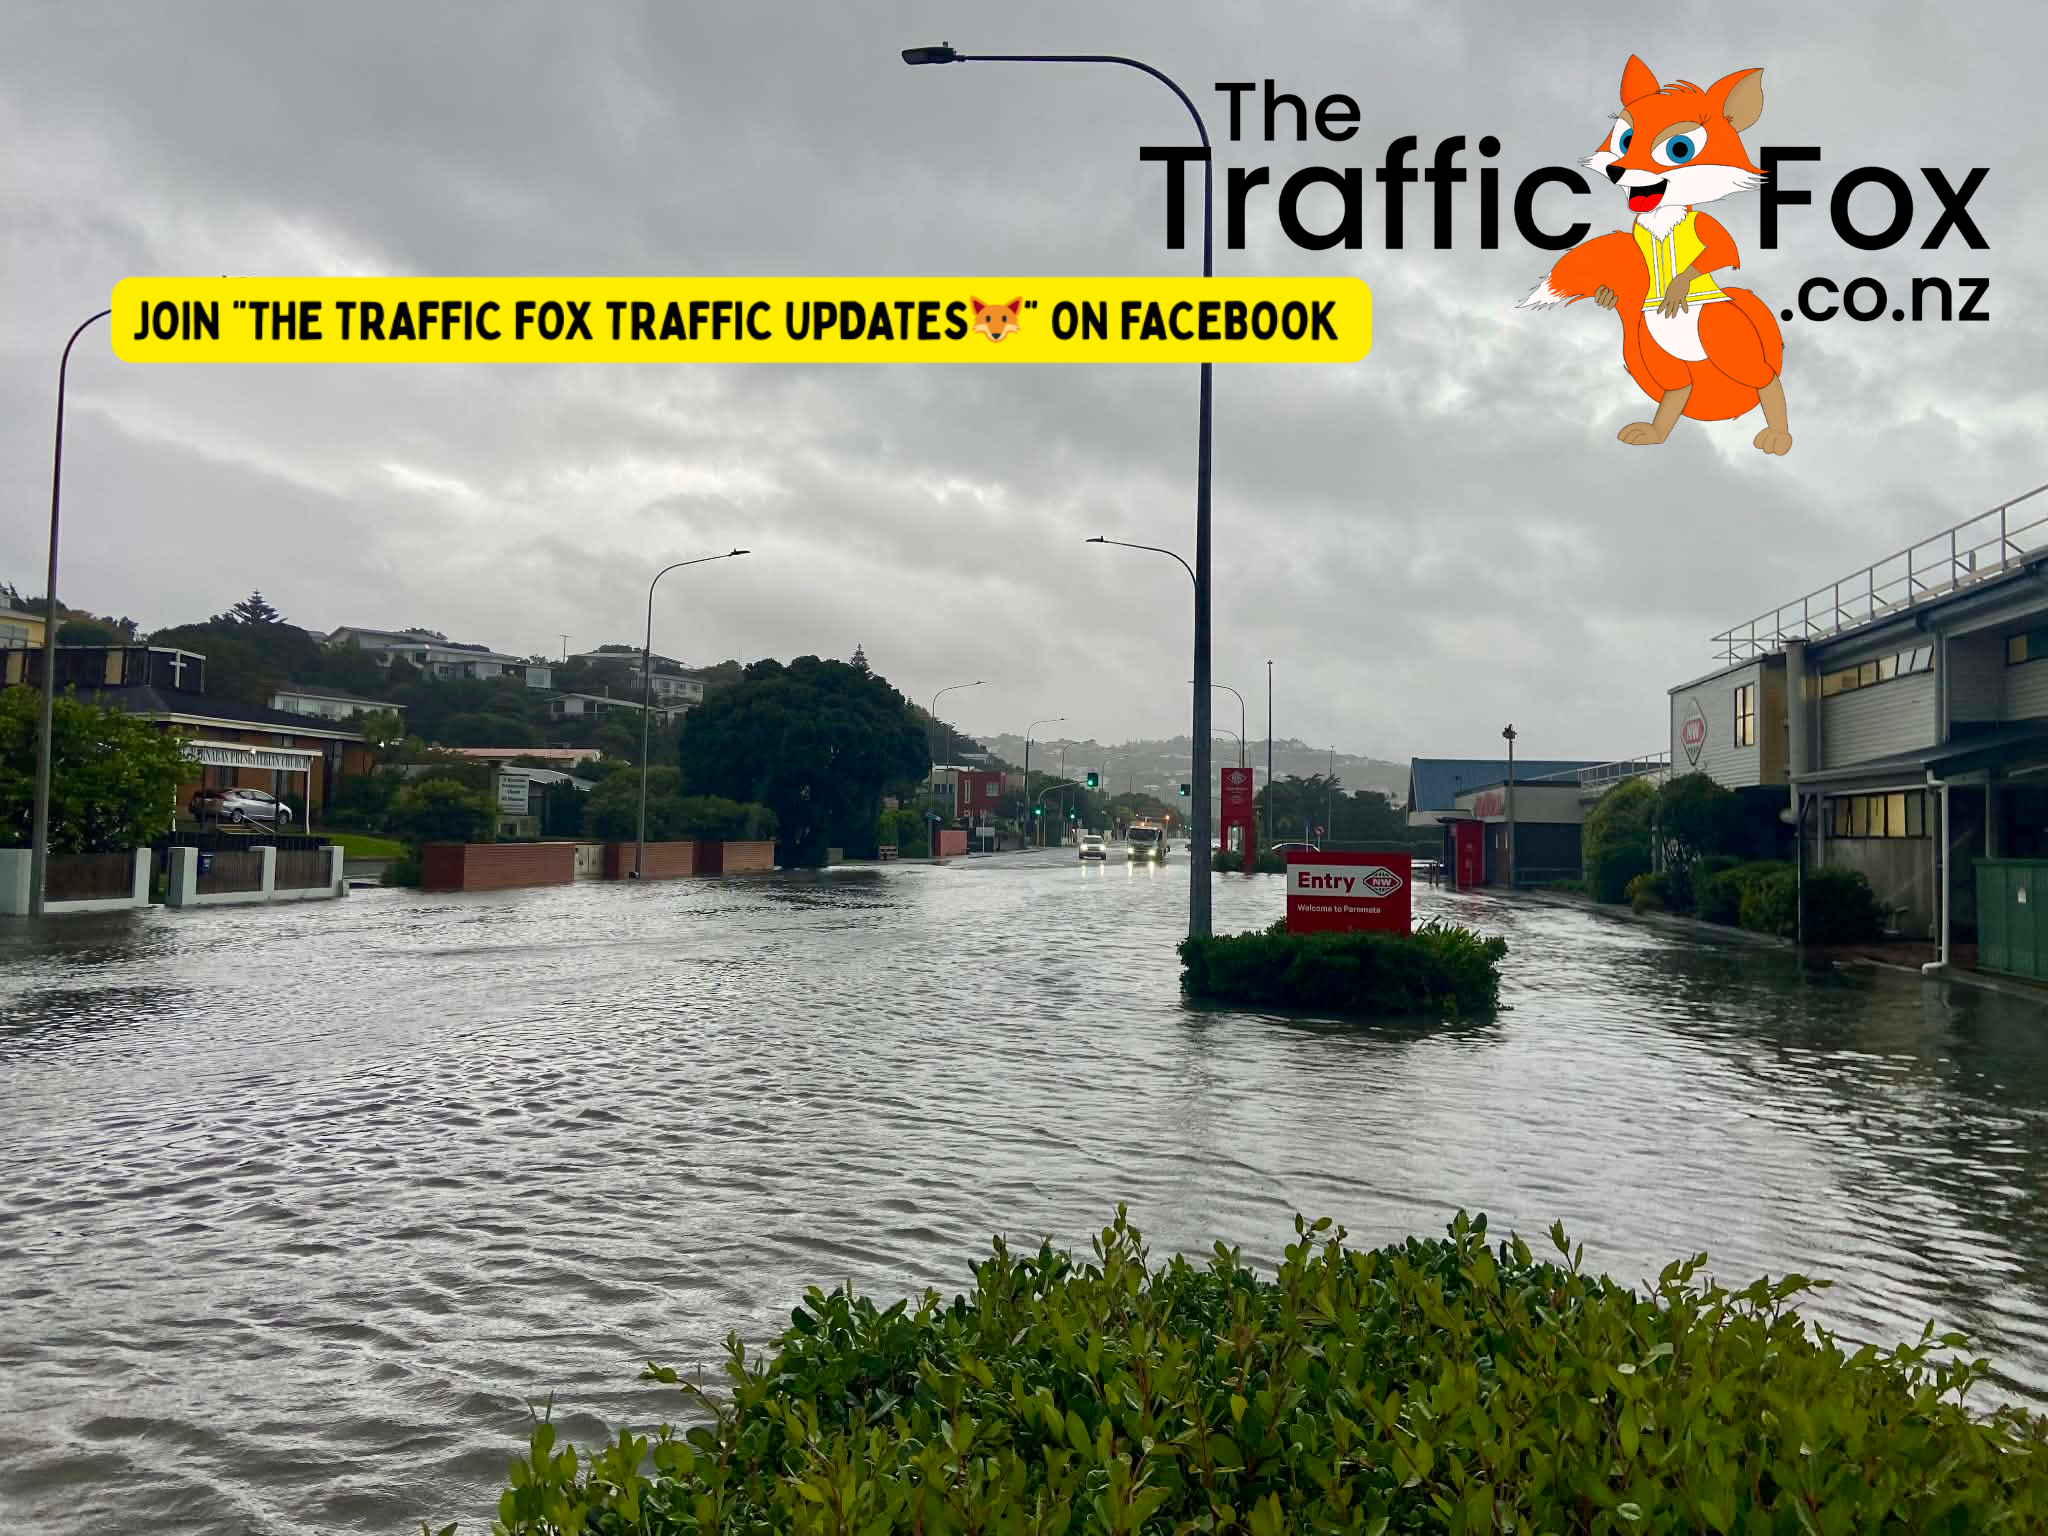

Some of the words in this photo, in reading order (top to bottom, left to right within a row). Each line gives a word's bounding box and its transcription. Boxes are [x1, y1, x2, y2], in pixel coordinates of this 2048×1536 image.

[1298, 871, 1356, 893] Entry
[1372, 877, 1392, 887] NW
[1297, 904, 1332, 913] Welcome
[1334, 904, 1342, 913] to
